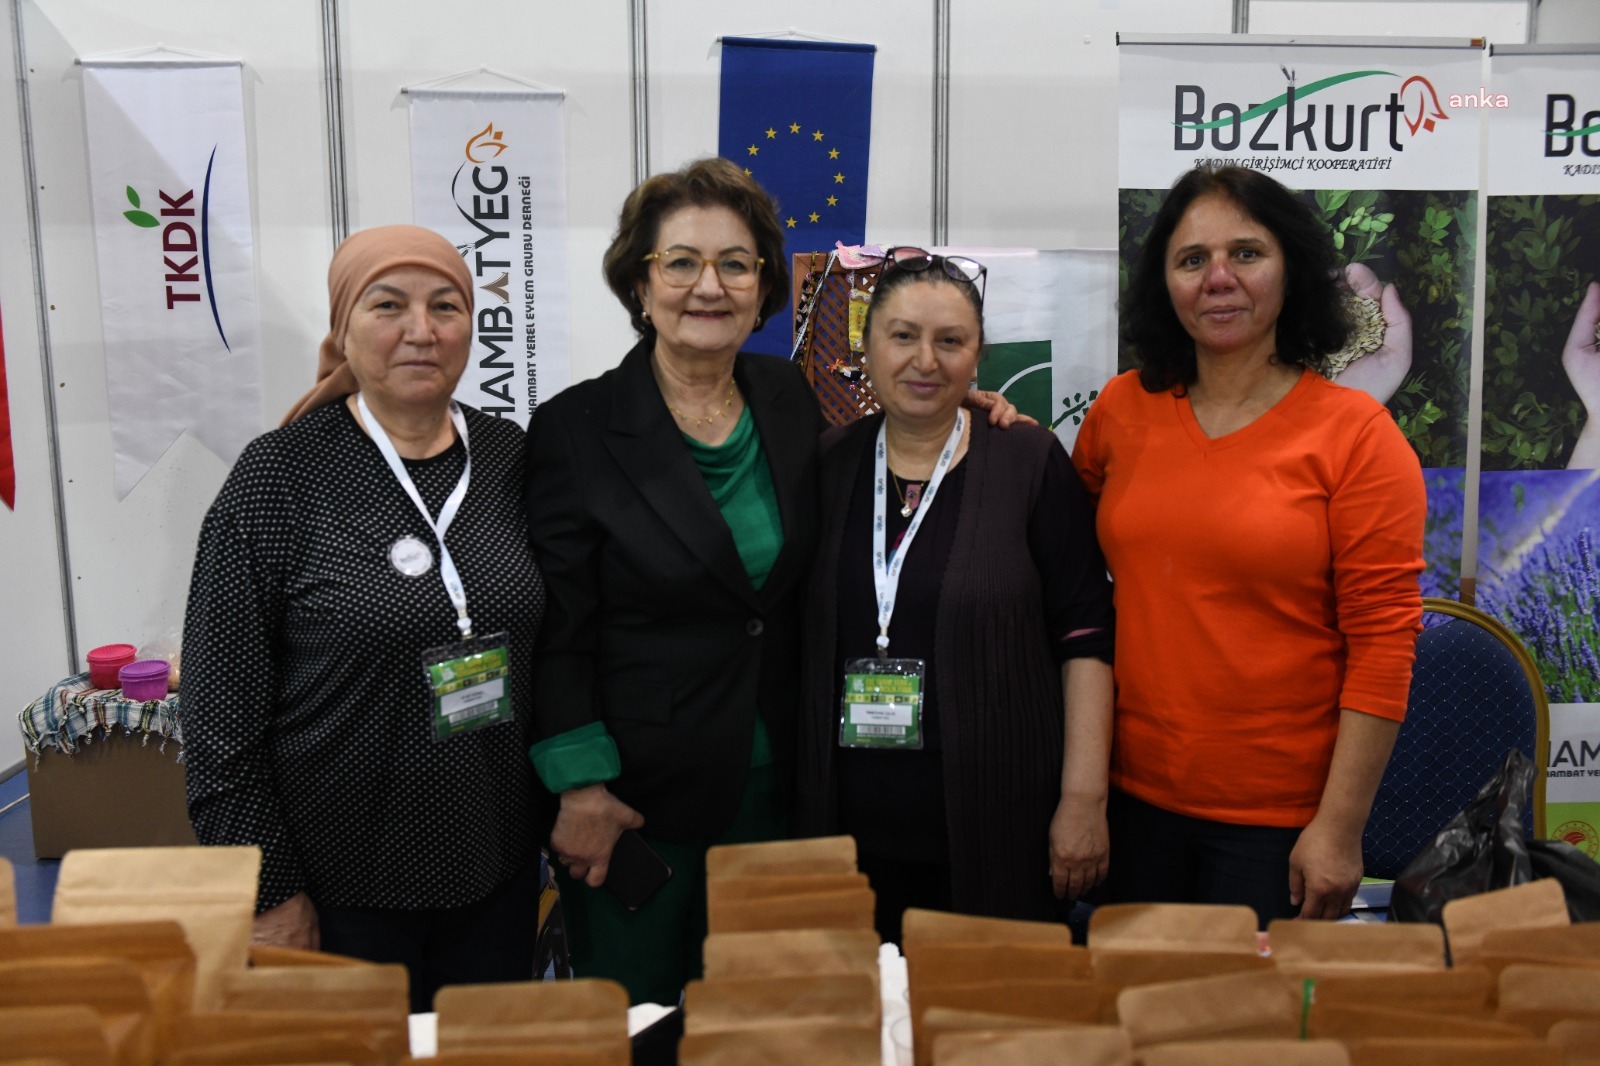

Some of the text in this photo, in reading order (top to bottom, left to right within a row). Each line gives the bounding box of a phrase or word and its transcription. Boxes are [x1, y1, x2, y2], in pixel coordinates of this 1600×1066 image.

[1173, 84, 1405, 152] Bozkurt
[1306, 156, 1392, 172] KOOPERATİFİ
[1563, 164, 1600, 177] KADI
[158, 188, 201, 310] TKDK
[518, 176, 537, 416] HAMBAT YEREL EYLEM GRUBU DERNEĞİ
